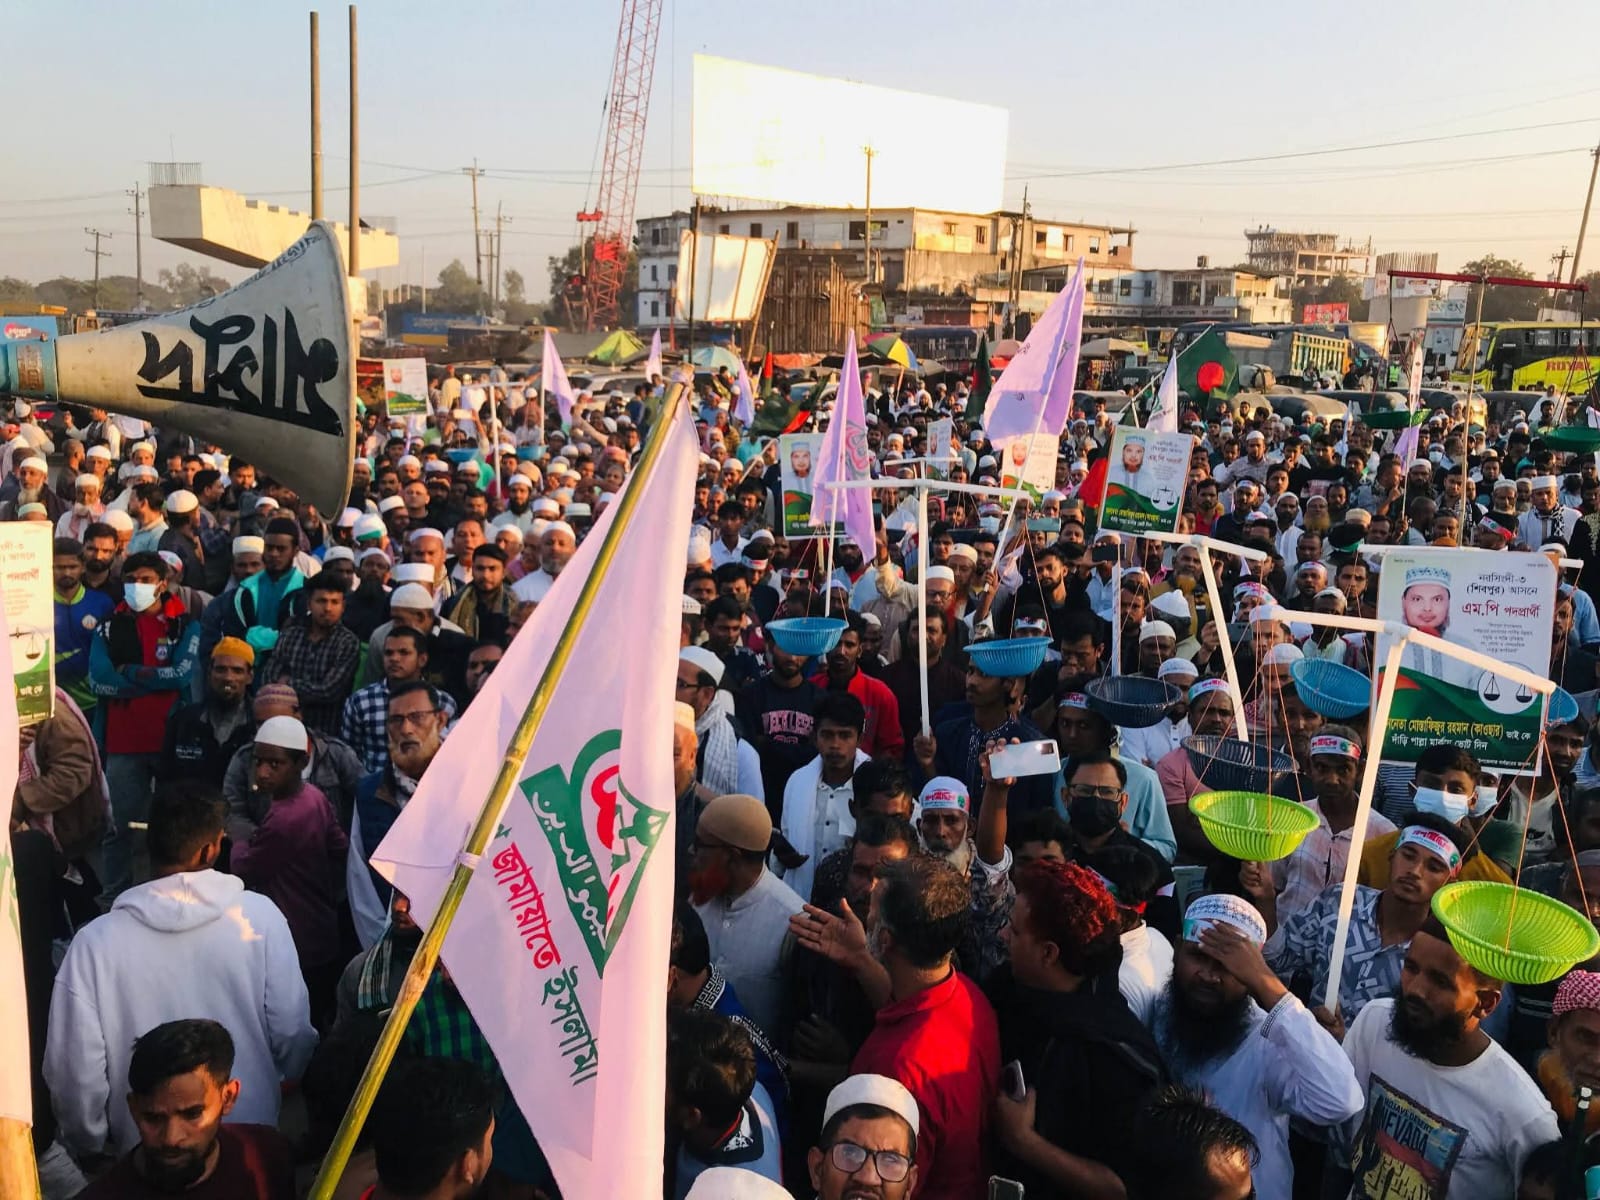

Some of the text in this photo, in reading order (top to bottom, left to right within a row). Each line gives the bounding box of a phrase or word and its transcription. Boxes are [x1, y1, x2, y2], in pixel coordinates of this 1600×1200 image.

[136, 306, 344, 437] মাসুদ
[1478, 572, 1527, 584] নরসিংদী-৩
[1466, 583, 1538, 596] (শিবপুর) আসনে
[1461, 599, 1499, 617] এম.পি
[492, 842, 561, 969] জামায়াতে
